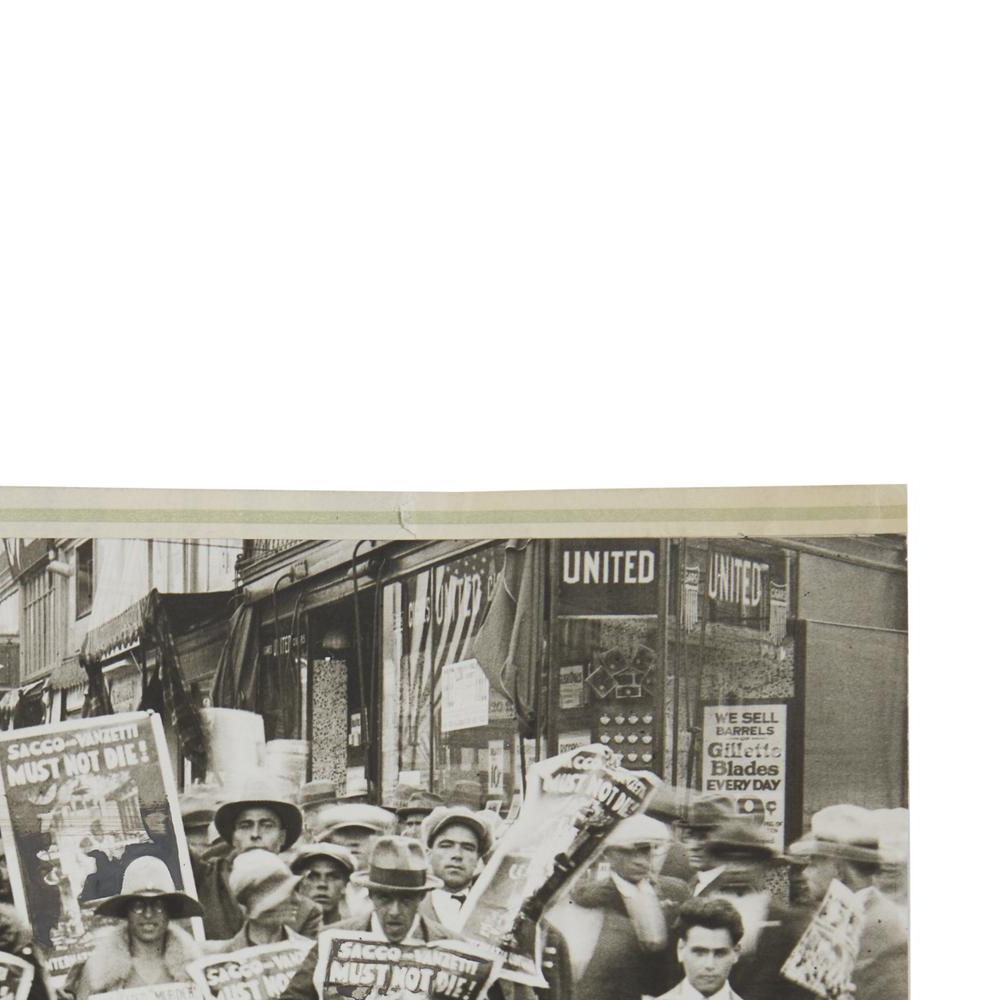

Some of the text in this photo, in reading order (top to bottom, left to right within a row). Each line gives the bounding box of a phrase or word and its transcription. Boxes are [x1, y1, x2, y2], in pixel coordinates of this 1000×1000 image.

[563, 550, 655, 584] UNITED
[708, 552, 762, 607] UNITED
[715, 712, 779, 724] WE SELL
[716, 726, 775, 736] BARRELS
[6, 740, 150, 787] MUST NOT DIE!
[711, 760, 779, 777] Blades
[706, 779, 781, 791] EVERY DAY
[329, 960, 477, 1000] MUST NOT DIE!
